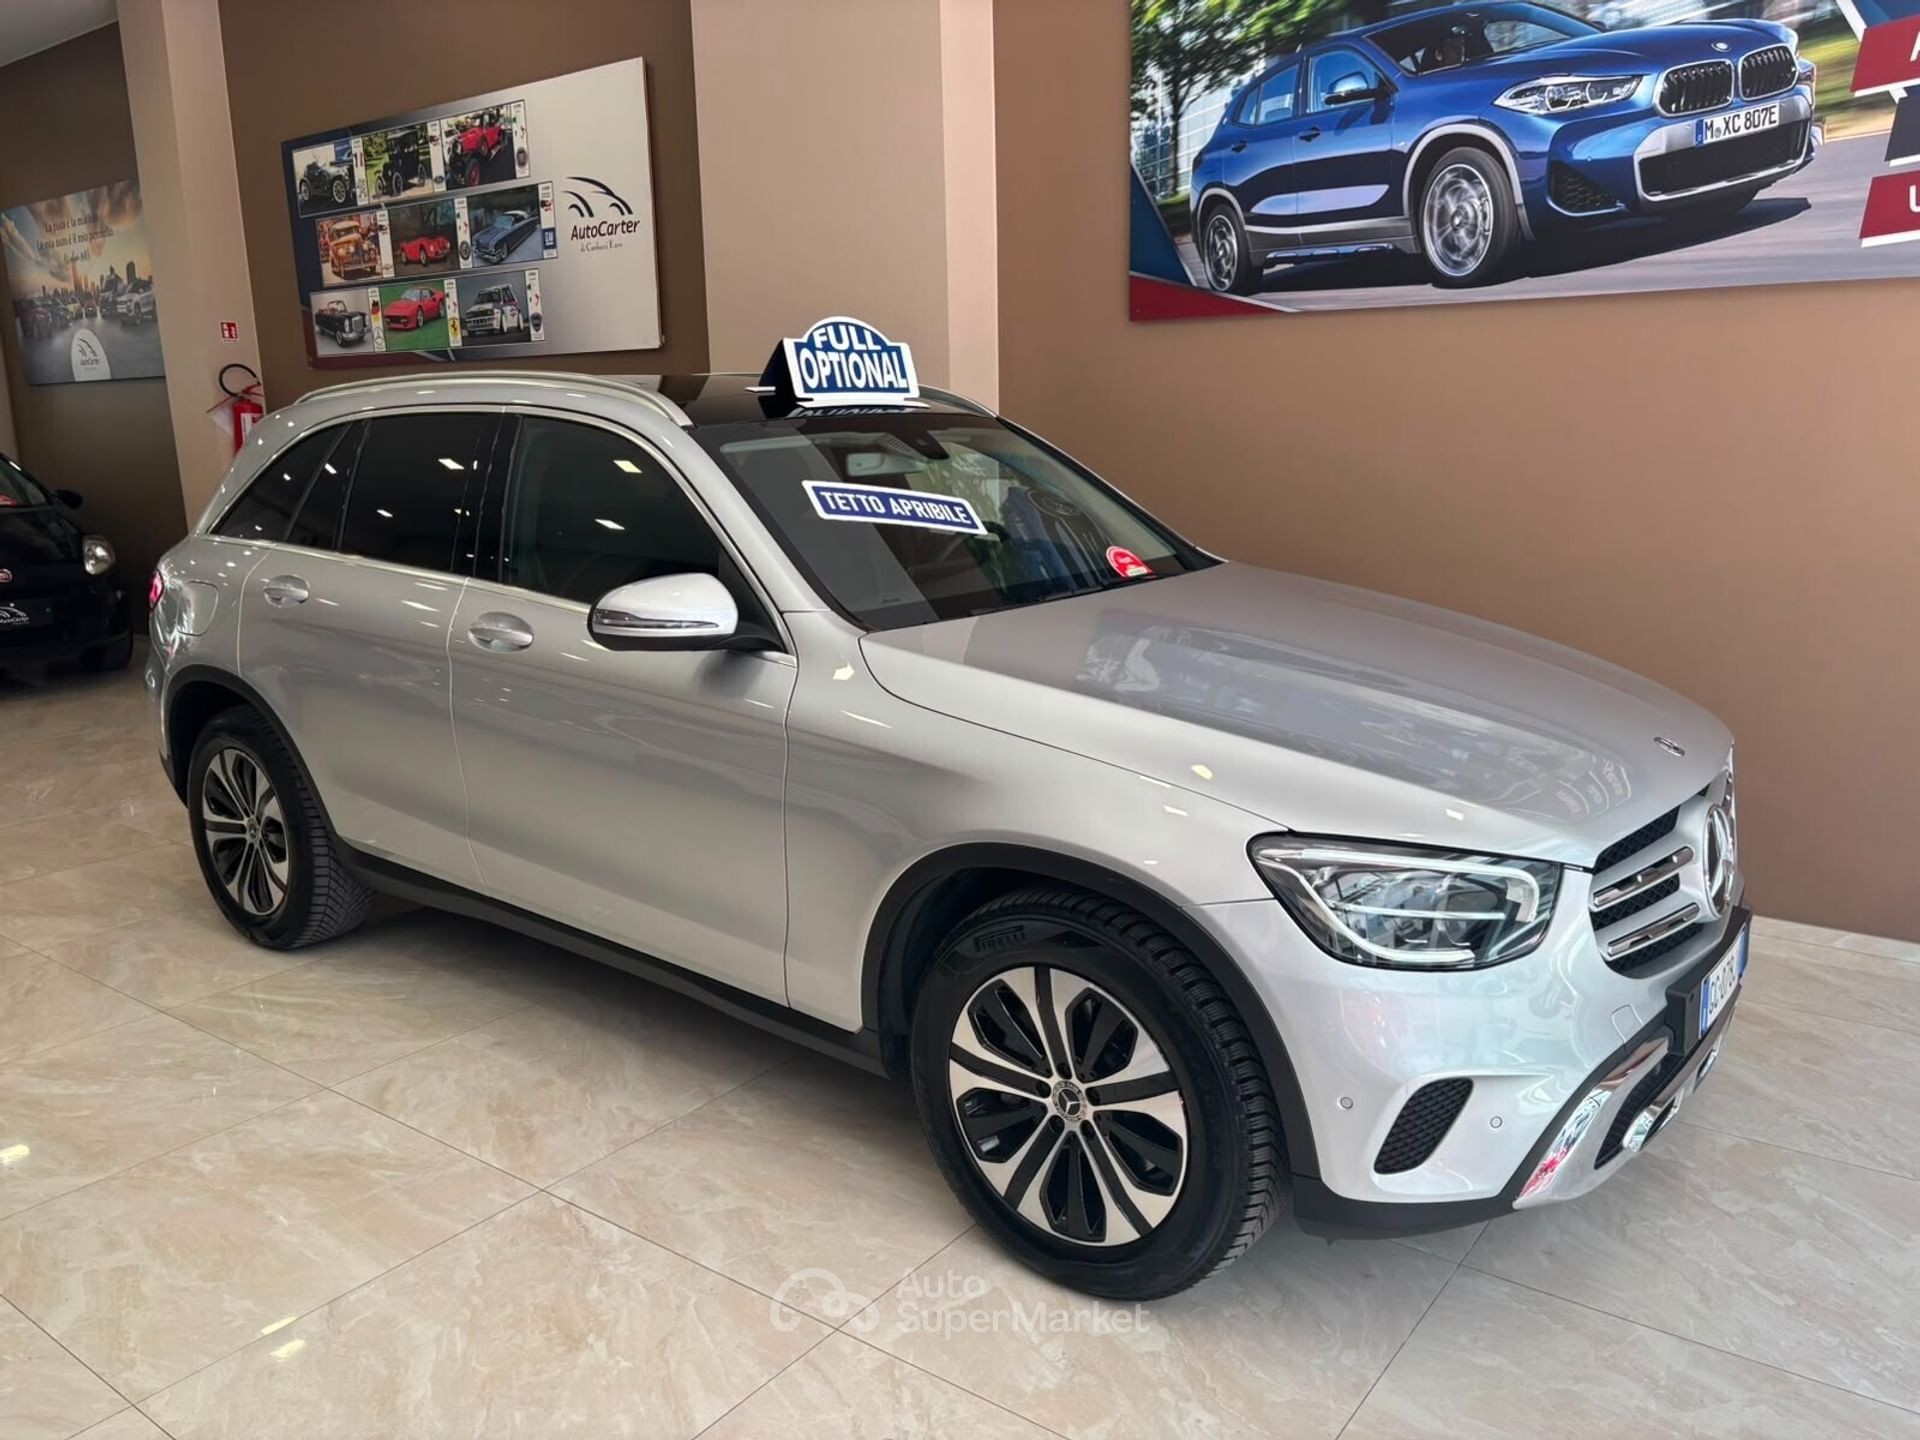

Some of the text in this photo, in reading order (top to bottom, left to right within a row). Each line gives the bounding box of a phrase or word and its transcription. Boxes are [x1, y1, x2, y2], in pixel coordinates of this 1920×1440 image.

[571, 220, 640, 241] AutoCarter
[812, 324, 882, 351] FULL
[799, 347, 909, 389] OPTIONAL
[820, 491, 972, 525] TETTO APRIBILE
[974, 924, 1026, 952] PIRELLI
